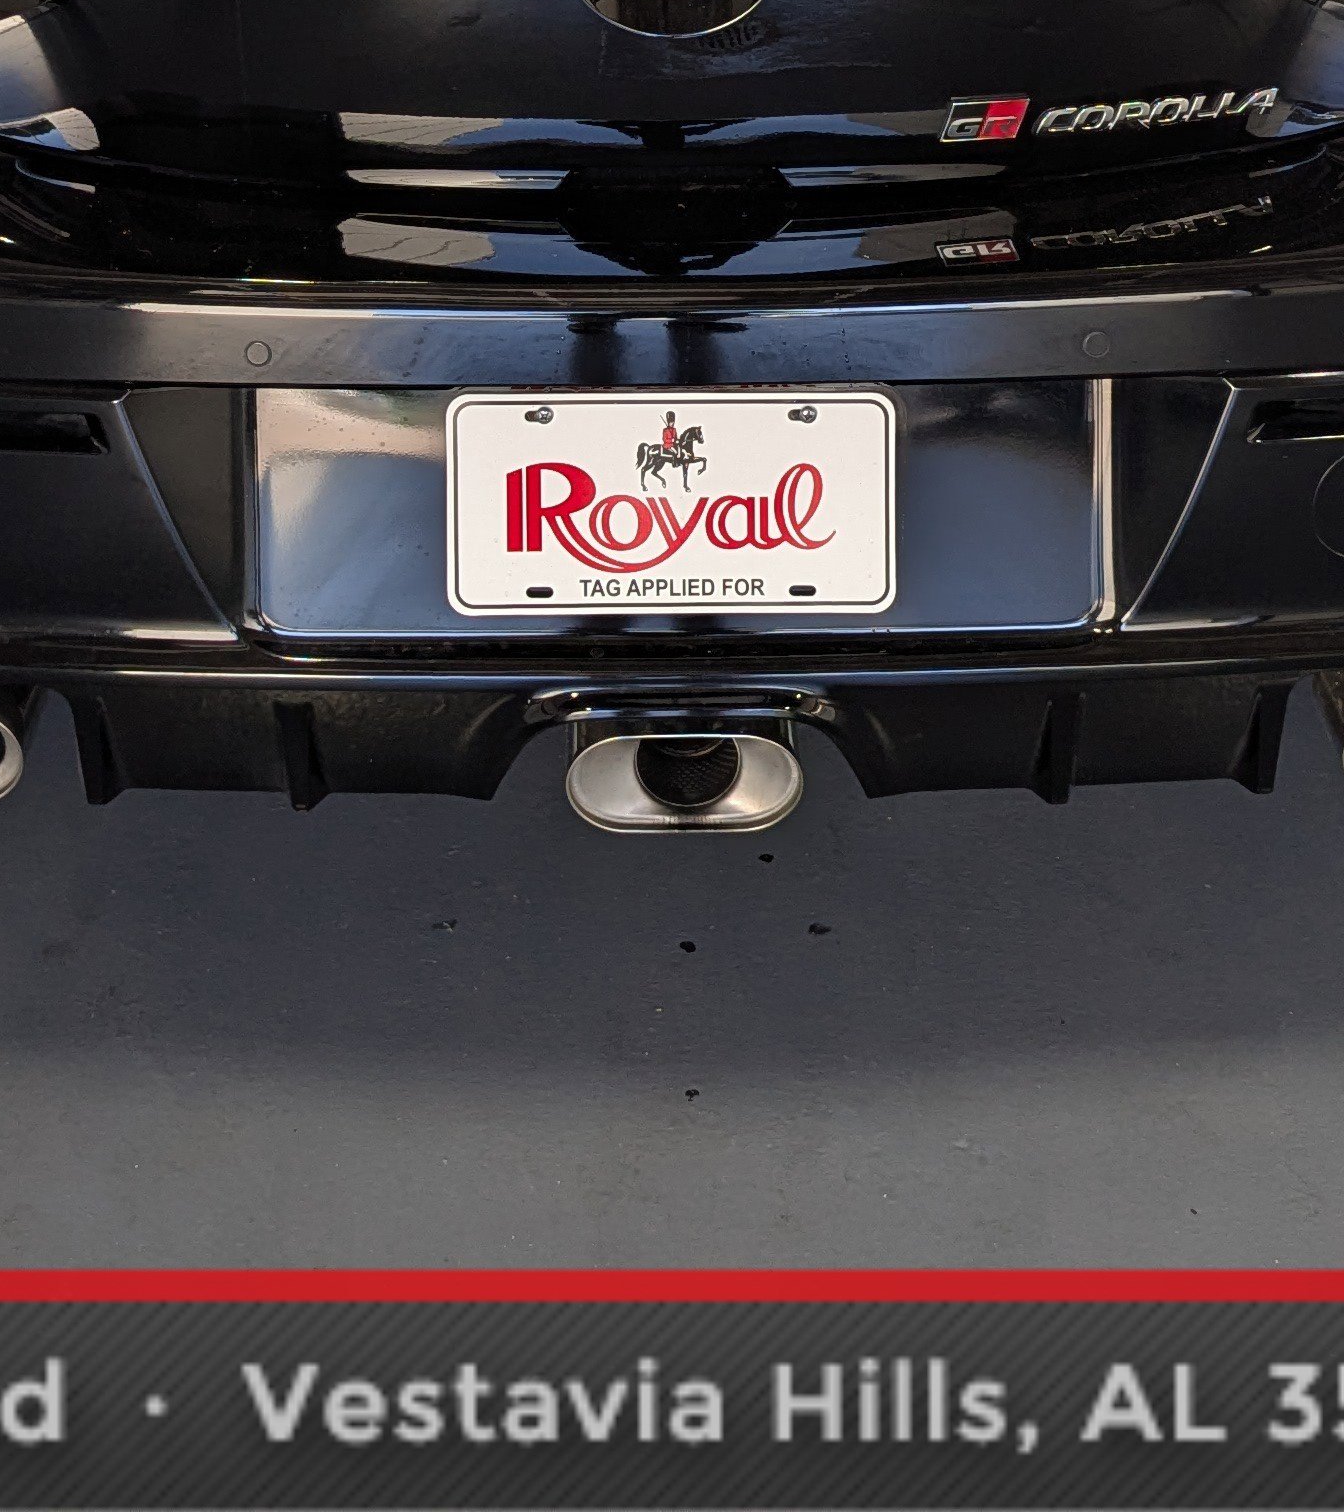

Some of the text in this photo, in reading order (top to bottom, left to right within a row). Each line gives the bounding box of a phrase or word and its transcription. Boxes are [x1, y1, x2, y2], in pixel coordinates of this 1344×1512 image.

[1033, 88, 1279, 134] COROLLA
[506, 461, 837, 574] Royal
[579, 578, 765, 597] TAG APPLIED FOR
